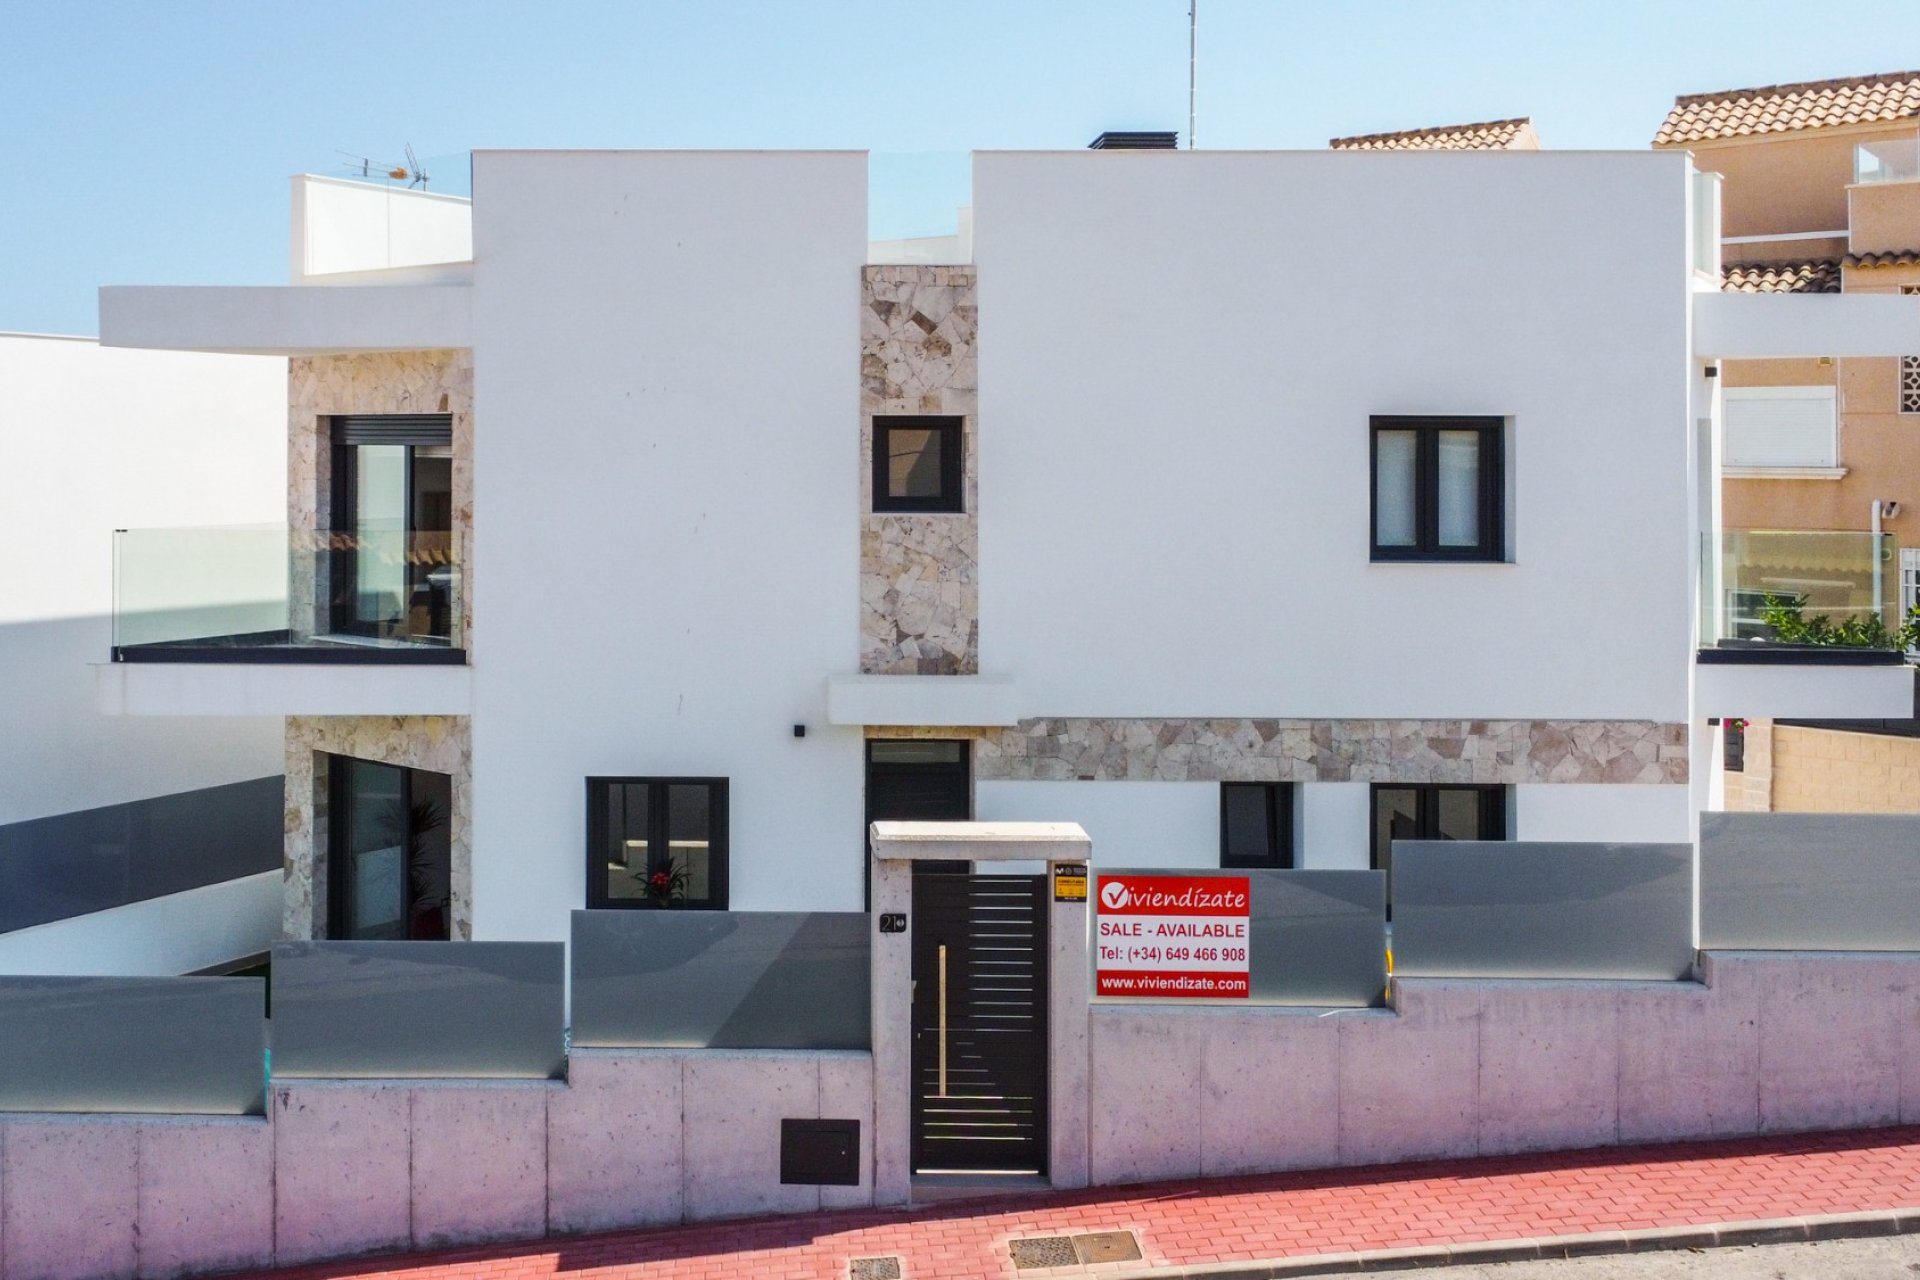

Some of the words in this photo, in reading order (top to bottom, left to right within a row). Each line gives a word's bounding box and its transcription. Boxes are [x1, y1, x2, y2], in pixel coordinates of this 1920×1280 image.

[1100, 922, 1142, 937] SALE
[1156, 923, 1245, 938] AVAILABLE
[1099, 946, 1124, 960] Tel:
[1127, 946, 1162, 964] (+34)
[1167, 948, 1190, 961] 649
[1193, 948, 1218, 961] 466
[1221, 948, 1246, 962] 908
[1101, 976, 1246, 991] www.viviendizate.com
